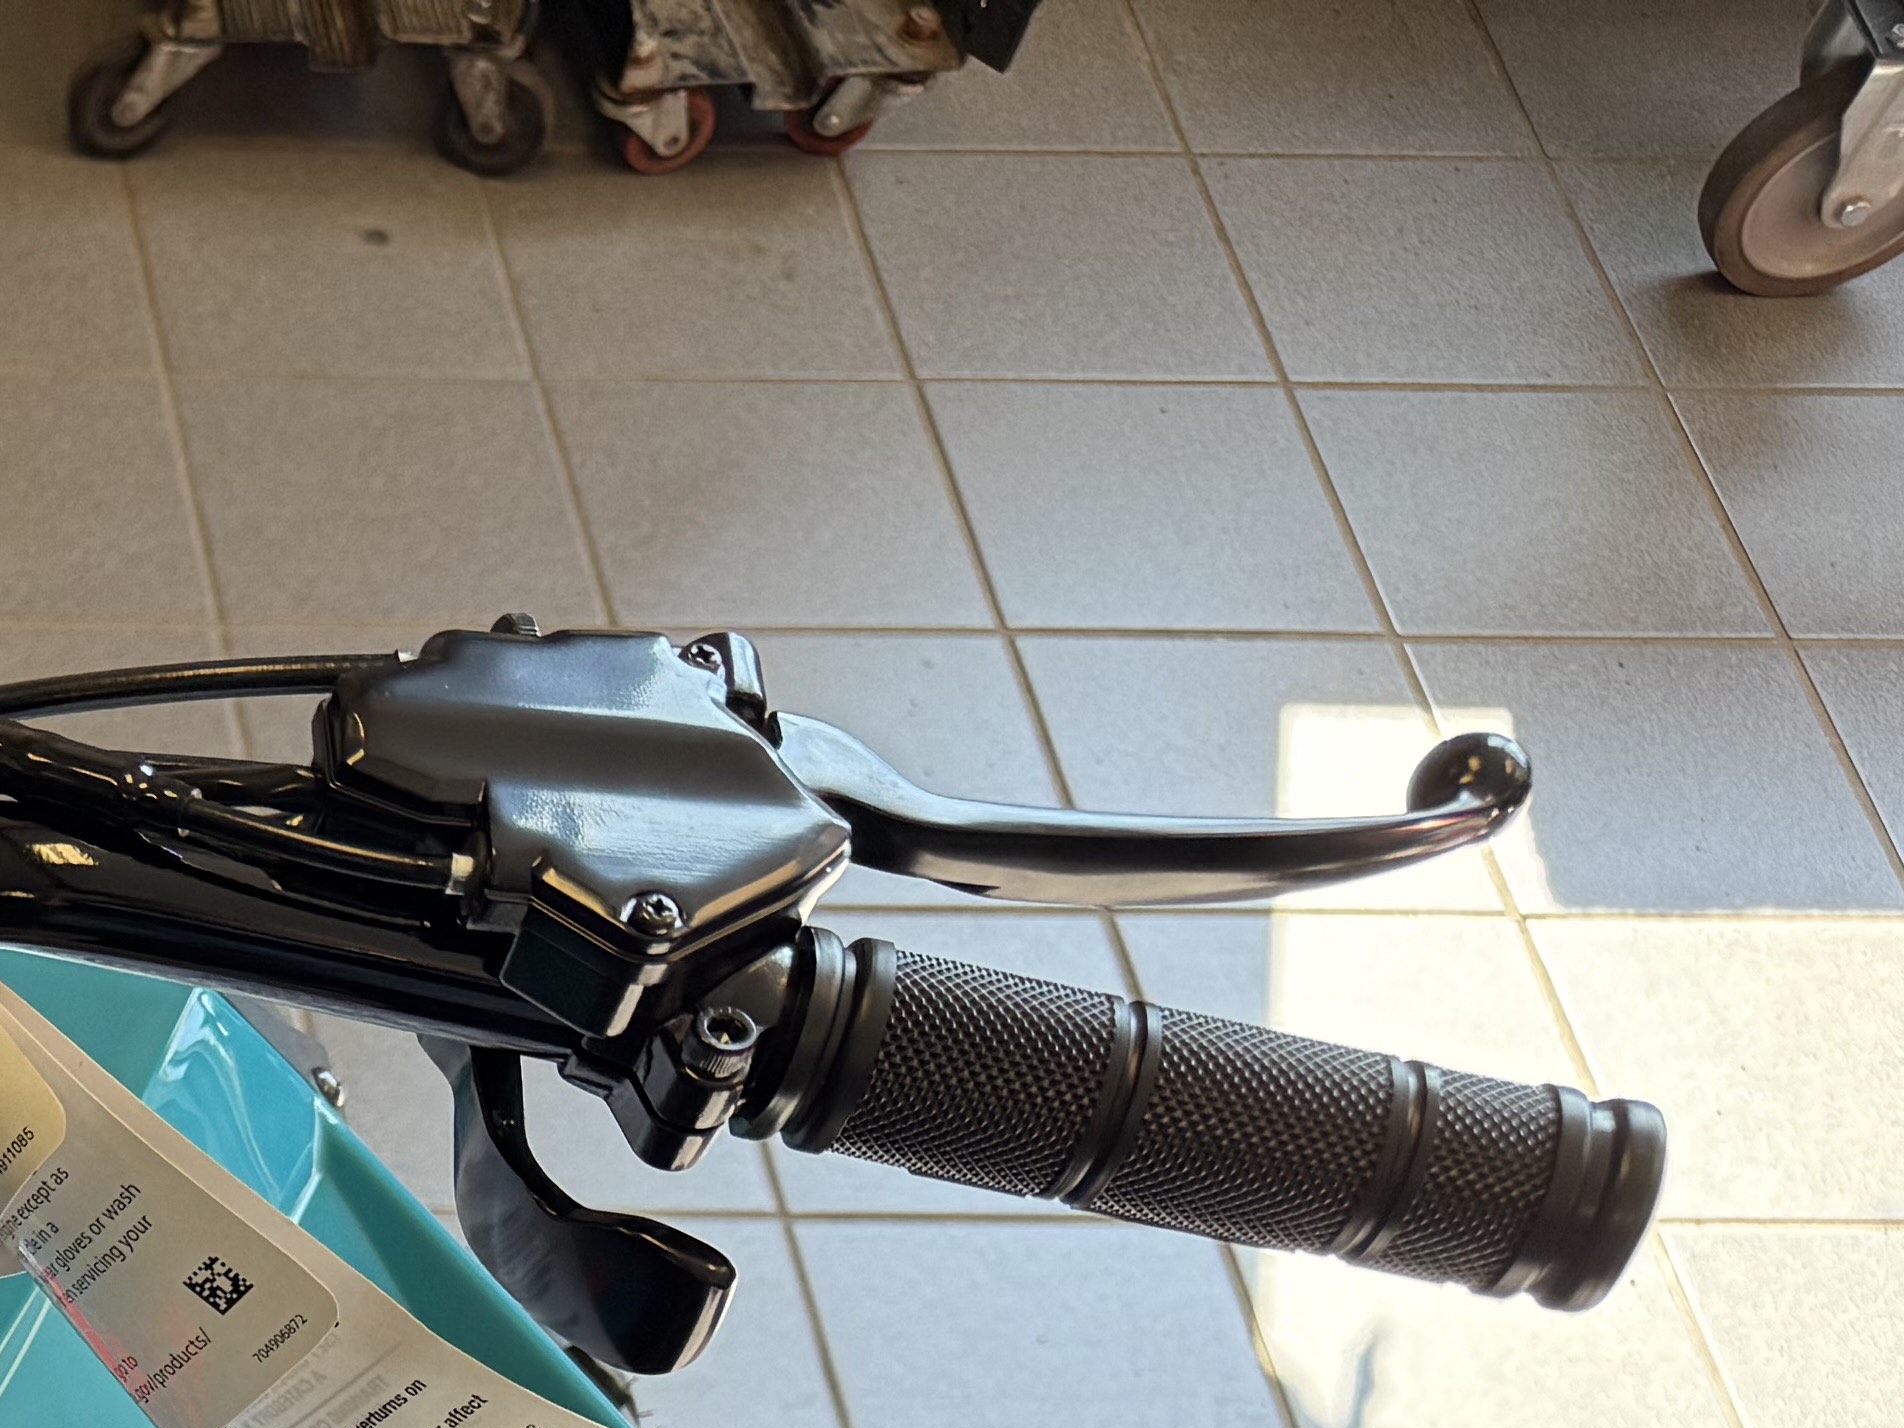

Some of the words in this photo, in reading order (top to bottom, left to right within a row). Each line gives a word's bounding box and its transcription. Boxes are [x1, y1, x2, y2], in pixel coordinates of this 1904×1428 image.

[15, 1179, 57, 1221] except
[48, 1166, 70, 1186] as
[31, 1228, 53, 1245] in
[44, 1220, 60, 1235] a
[53, 1230, 94, 1273] gloves
[87, 1215, 107, 1236] or
[100, 1183, 142, 1221] wash
[70, 1244, 128, 1296] servicing
[116, 1214, 153, 1254] your
[250, 1312, 309, 1364] 704906872
[403, 1378, 428, 1397] on
[443, 1393, 489, 1428] affect
